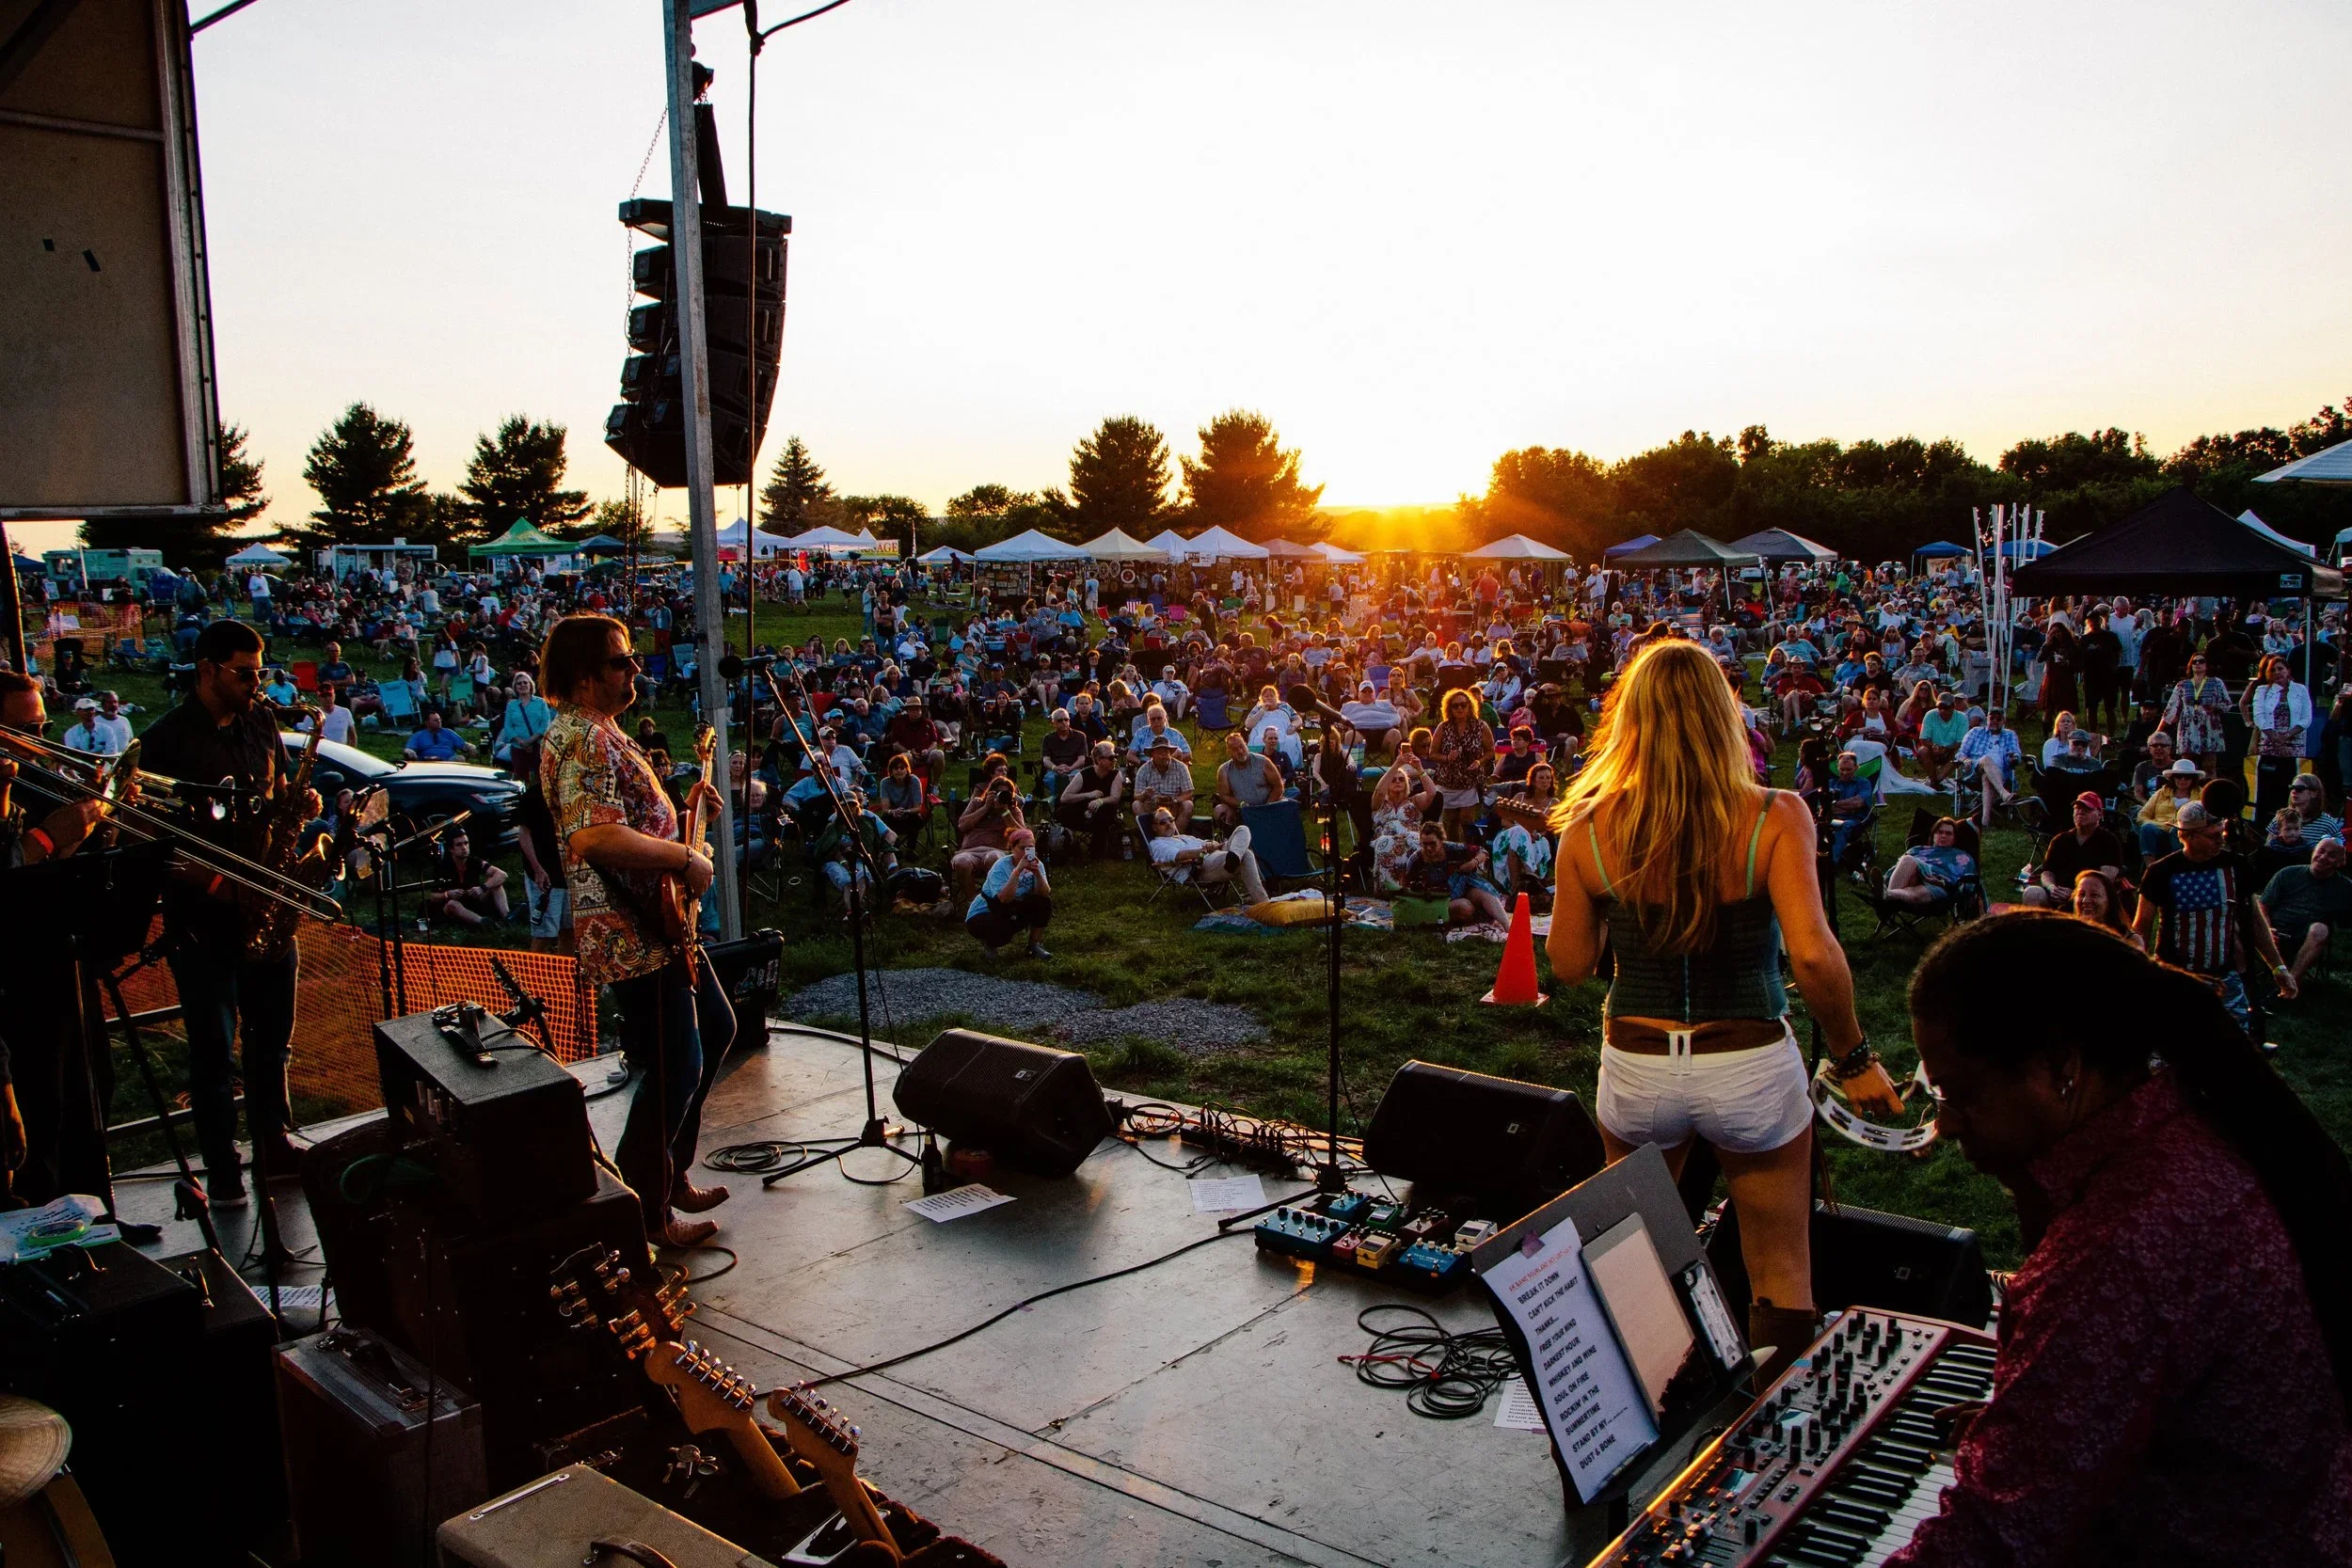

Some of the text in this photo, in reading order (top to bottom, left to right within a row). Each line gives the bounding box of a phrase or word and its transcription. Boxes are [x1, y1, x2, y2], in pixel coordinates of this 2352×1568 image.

[1518, 1272, 1560, 1305] BREAK IT DOWN
[1543, 1294, 1556, 1308] KICK
[1554, 1287, 1564, 1298] THE
[1563, 1276, 1579, 1292] HABIT
[1539, 1318, 1577, 1354] FREE YOUR MIND
[1543, 1337, 1581, 1370] DARKEST HOUR
[1548, 1345, 1597, 1387] WHISKEY AND WINE
[1553, 1371, 1590, 1404] SOUL ON FIRE
[1581, 1394, 1589, 1403] IN
[1587, 1385, 1600, 1398] THE
[1565, 1402, 1600, 1435] SUMMERTIME
[1572, 1433, 1591, 1452] STAND
[1590, 1425, 1599, 1437] BY
[1580, 1434, 1616, 1469] DUST & BONE
